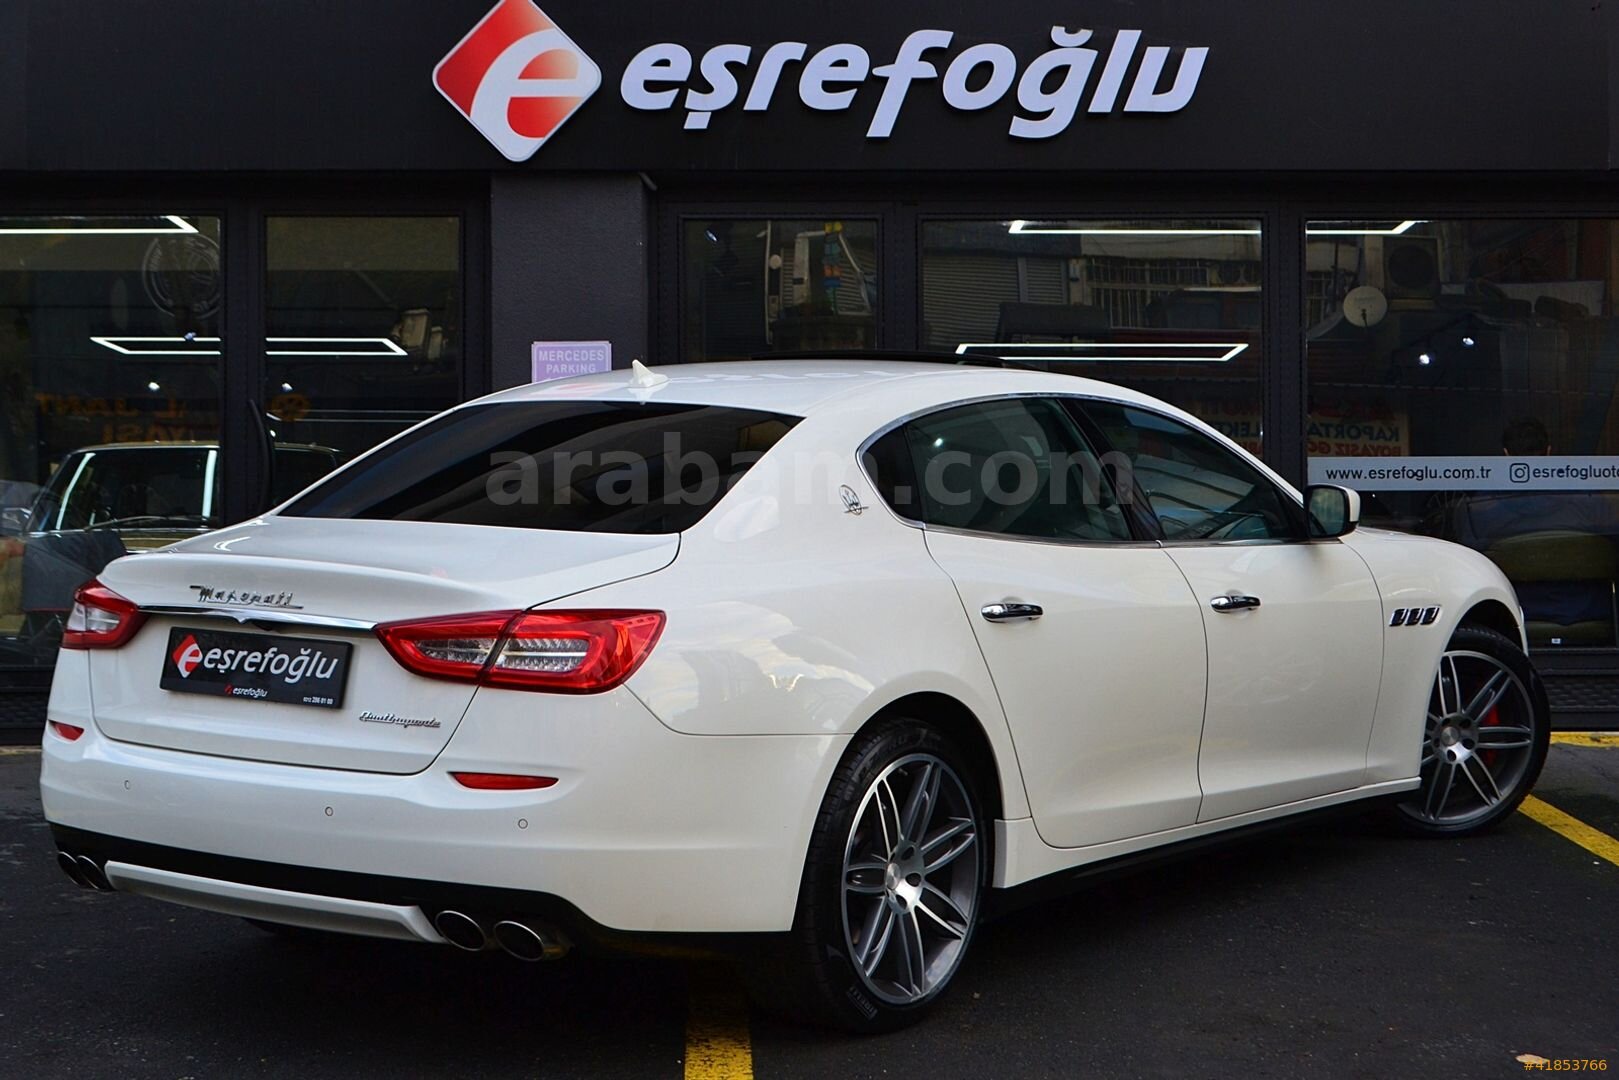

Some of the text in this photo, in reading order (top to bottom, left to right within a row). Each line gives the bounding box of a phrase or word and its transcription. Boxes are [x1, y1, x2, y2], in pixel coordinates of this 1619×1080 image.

[620, 25, 1210, 139] eşrefoğlu
[539, 350, 605, 361] MERCEDES
[546, 363, 596, 374] PARKING
[1326, 466, 1492, 481] www.esrefoglu.com.tr
[1532, 465, 1619, 480] esrefogluot
[203, 647, 338, 684] eşrefoğlu
